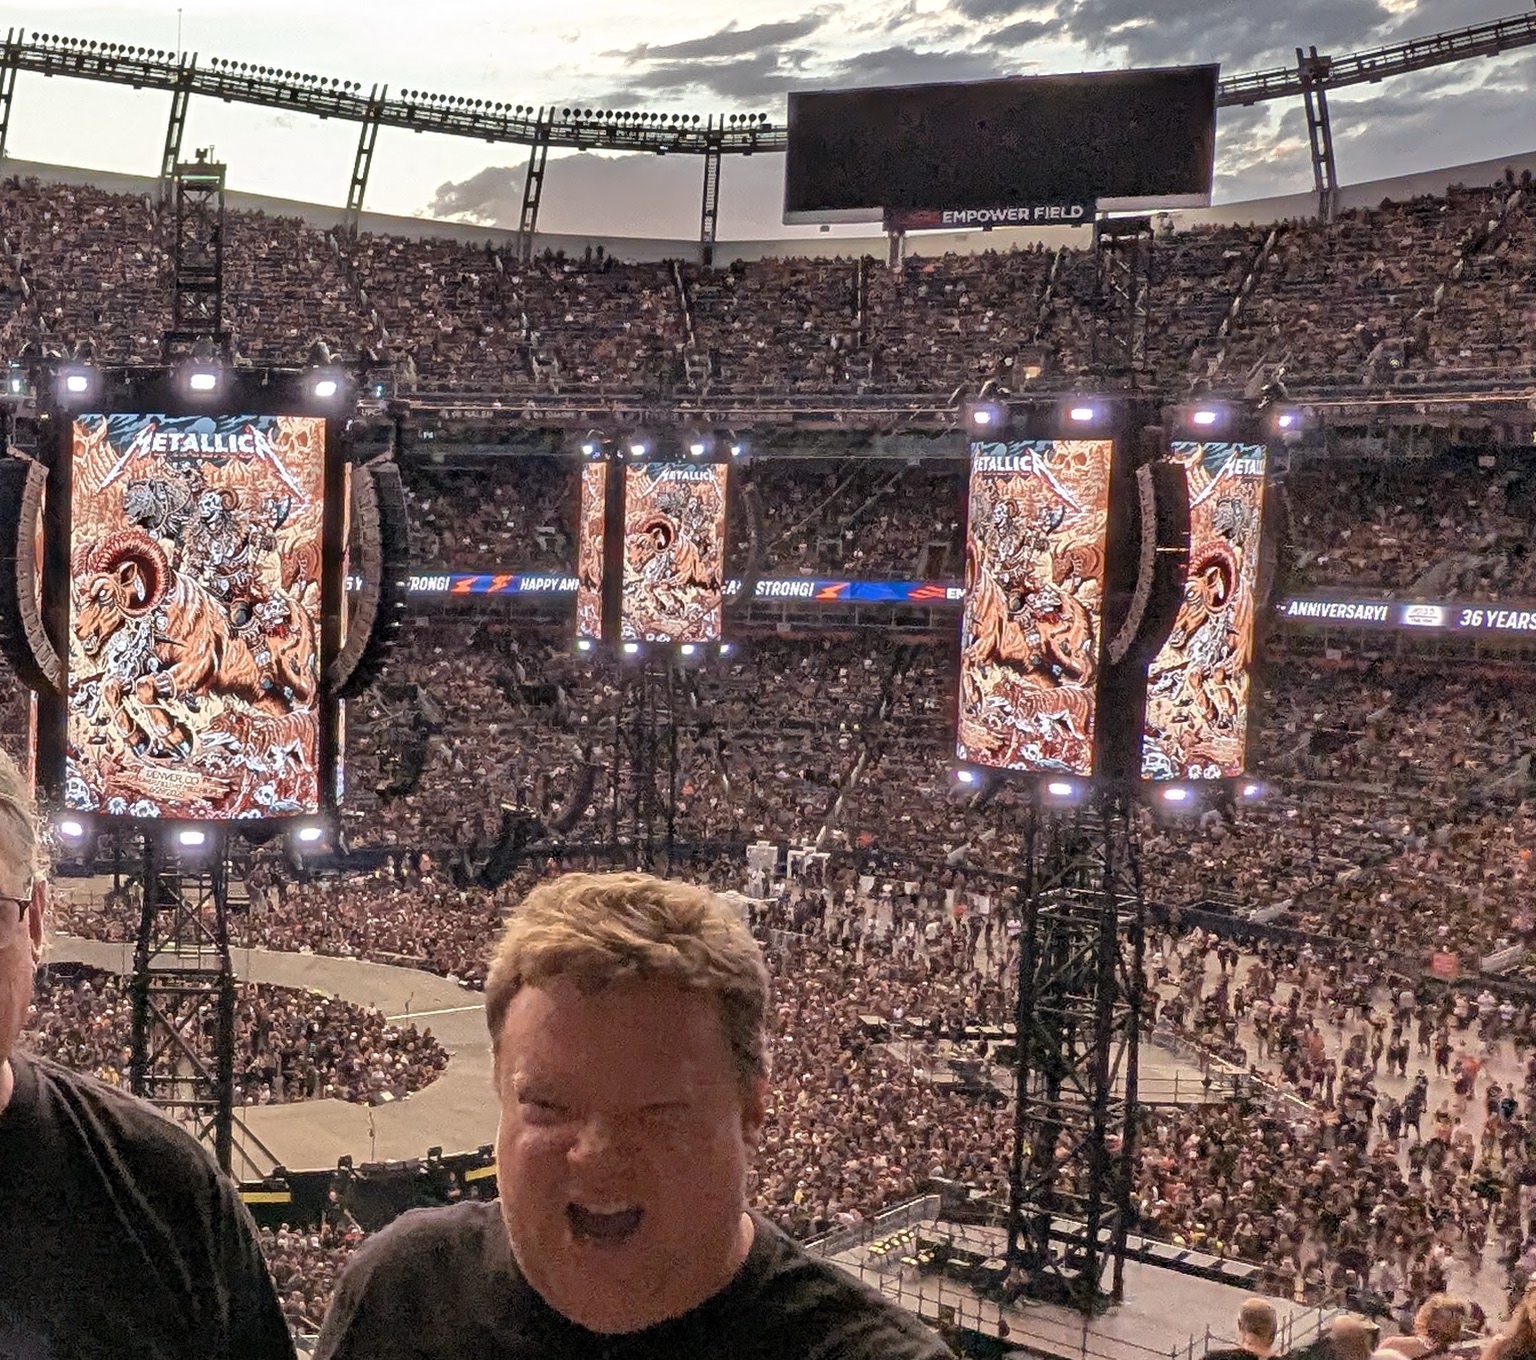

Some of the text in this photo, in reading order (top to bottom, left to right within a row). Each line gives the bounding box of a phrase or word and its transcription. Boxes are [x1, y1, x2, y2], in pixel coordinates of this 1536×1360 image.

[942, 205, 1084, 223] EMPOWER FIELD
[519, 577, 560, 591] HAPPY
[755, 581, 815, 598] STRONG!
[1288, 601, 1387, 621] ANNIVERSARY!
[1460, 609, 1536, 629] 36 YEARS
